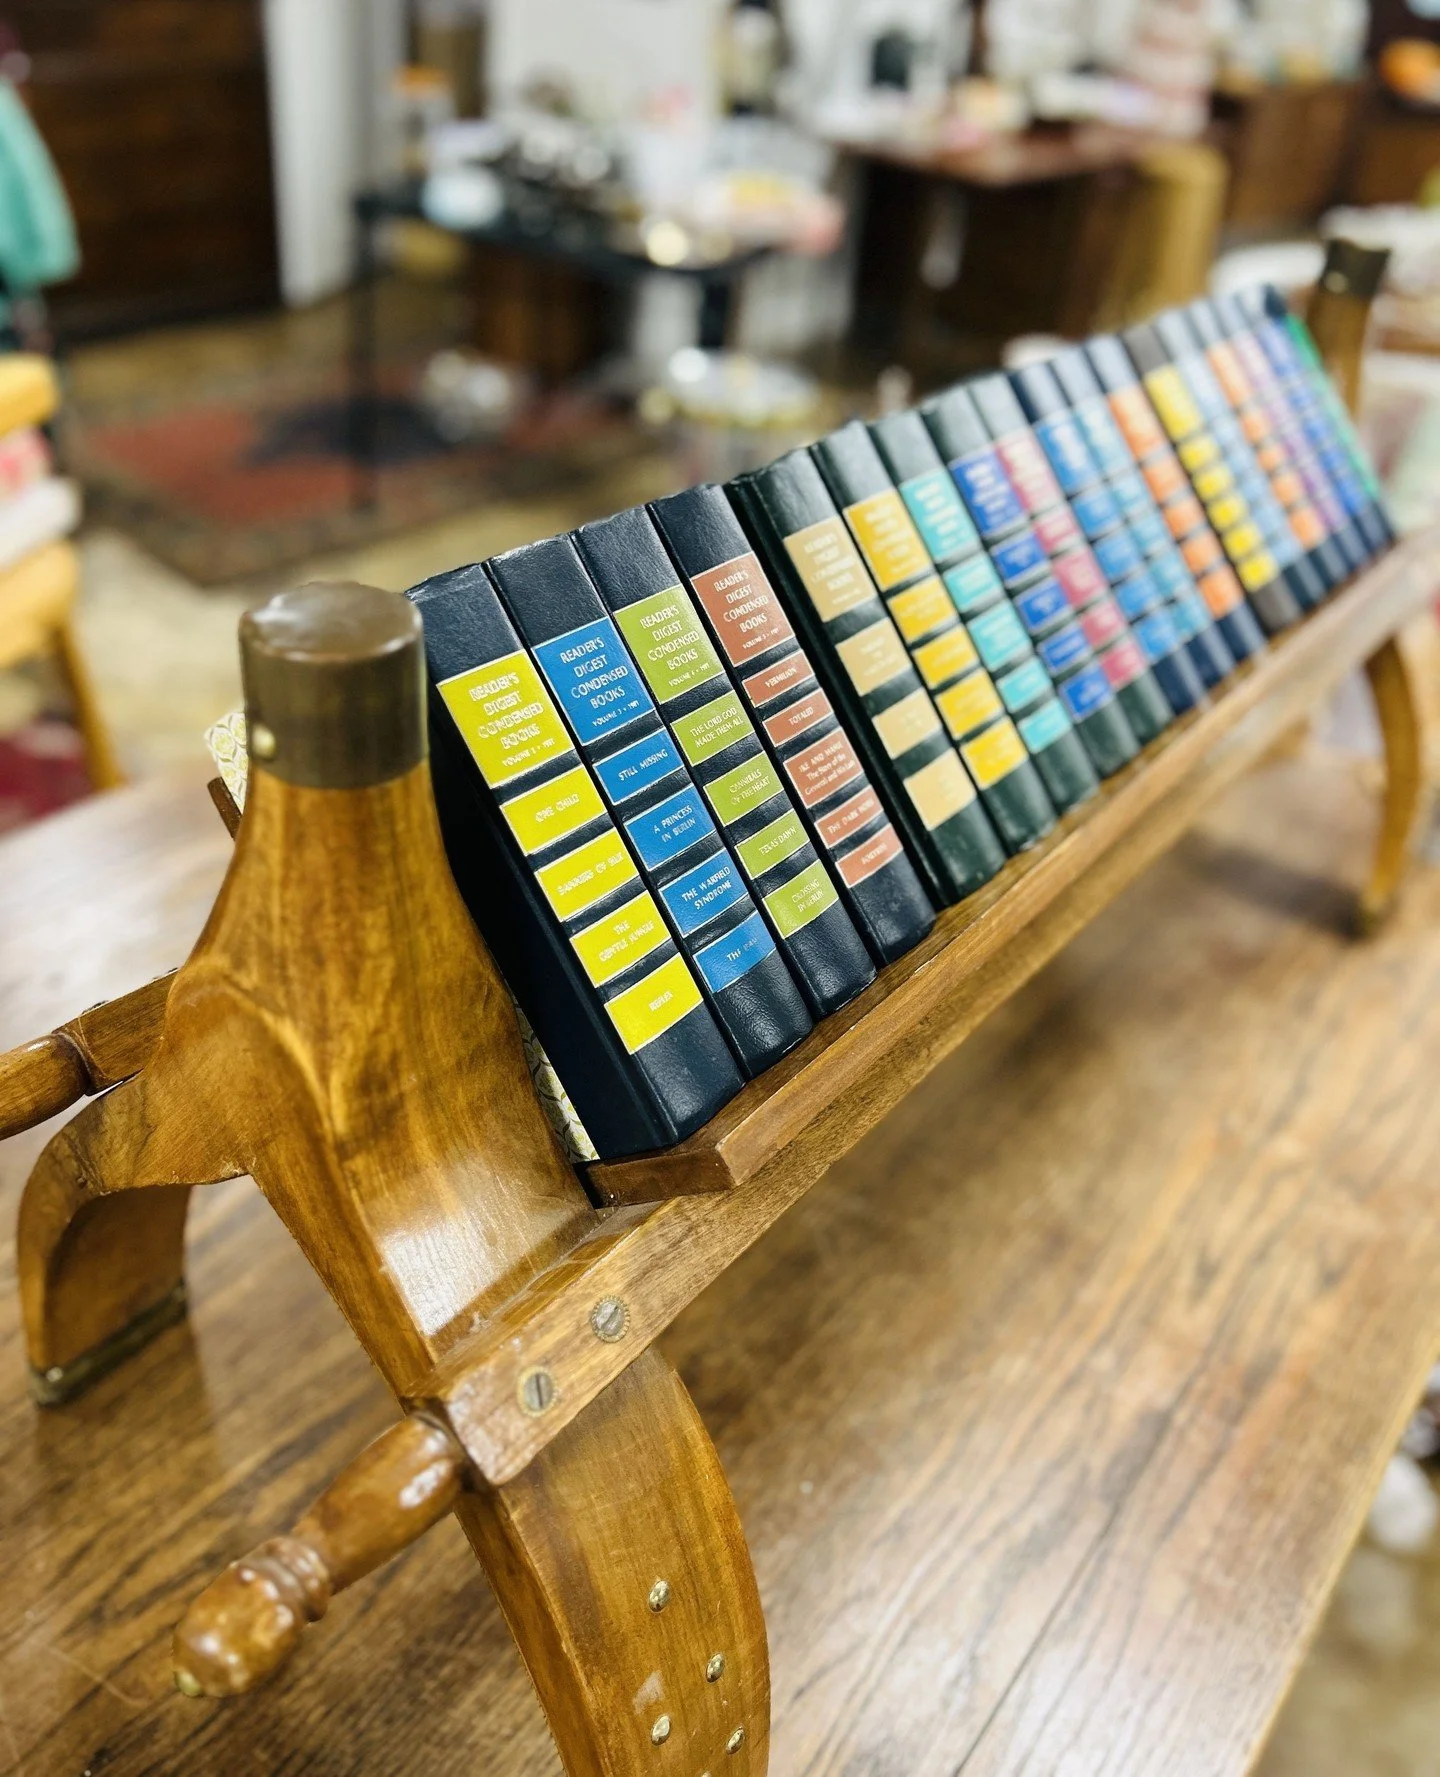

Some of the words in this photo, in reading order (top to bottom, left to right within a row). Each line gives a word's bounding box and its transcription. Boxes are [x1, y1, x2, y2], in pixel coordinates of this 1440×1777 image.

[713, 569, 749, 592] READER'S
[725, 584, 753, 604] DIGEST
[640, 604, 680, 629] READER'S
[723, 595, 769, 623] CONDENSED
[652, 620, 683, 642] DIGEST
[739, 612, 768, 633] BOOKS
[560, 636, 605, 664] READER'S
[647, 630, 700, 662] CONDENSED
[573, 655, 608, 678] DIGEST
[667, 648, 699, 671] BOOKS
[571, 665, 629, 699] CONDENSED
[590, 685, 626, 709] BOOKS
[690, 727, 705, 738] THE
[705, 716, 723, 730] LORD
[722, 707, 738, 721] GOD
[788, 706, 814, 725] TOTALED
[695, 731, 717, 748] MADE
[733, 716, 745, 727] ALL
[618, 766, 638, 781] STILL
[640, 749, 669, 770] MISSING
[729, 768, 762, 794] CANNIBALS
[752, 776, 771, 792] HEART
[653, 825, 661, 834] A
[661, 805, 693, 828] PRINCESS
[661, 832, 672, 843] IN
[672, 818, 697, 836] BERLIN
[779, 827, 797, 843] DAWN
[681, 887, 699, 902] THE
[699, 866, 731, 891] WARFIELD
[694, 880, 732, 910] SYNDROME
